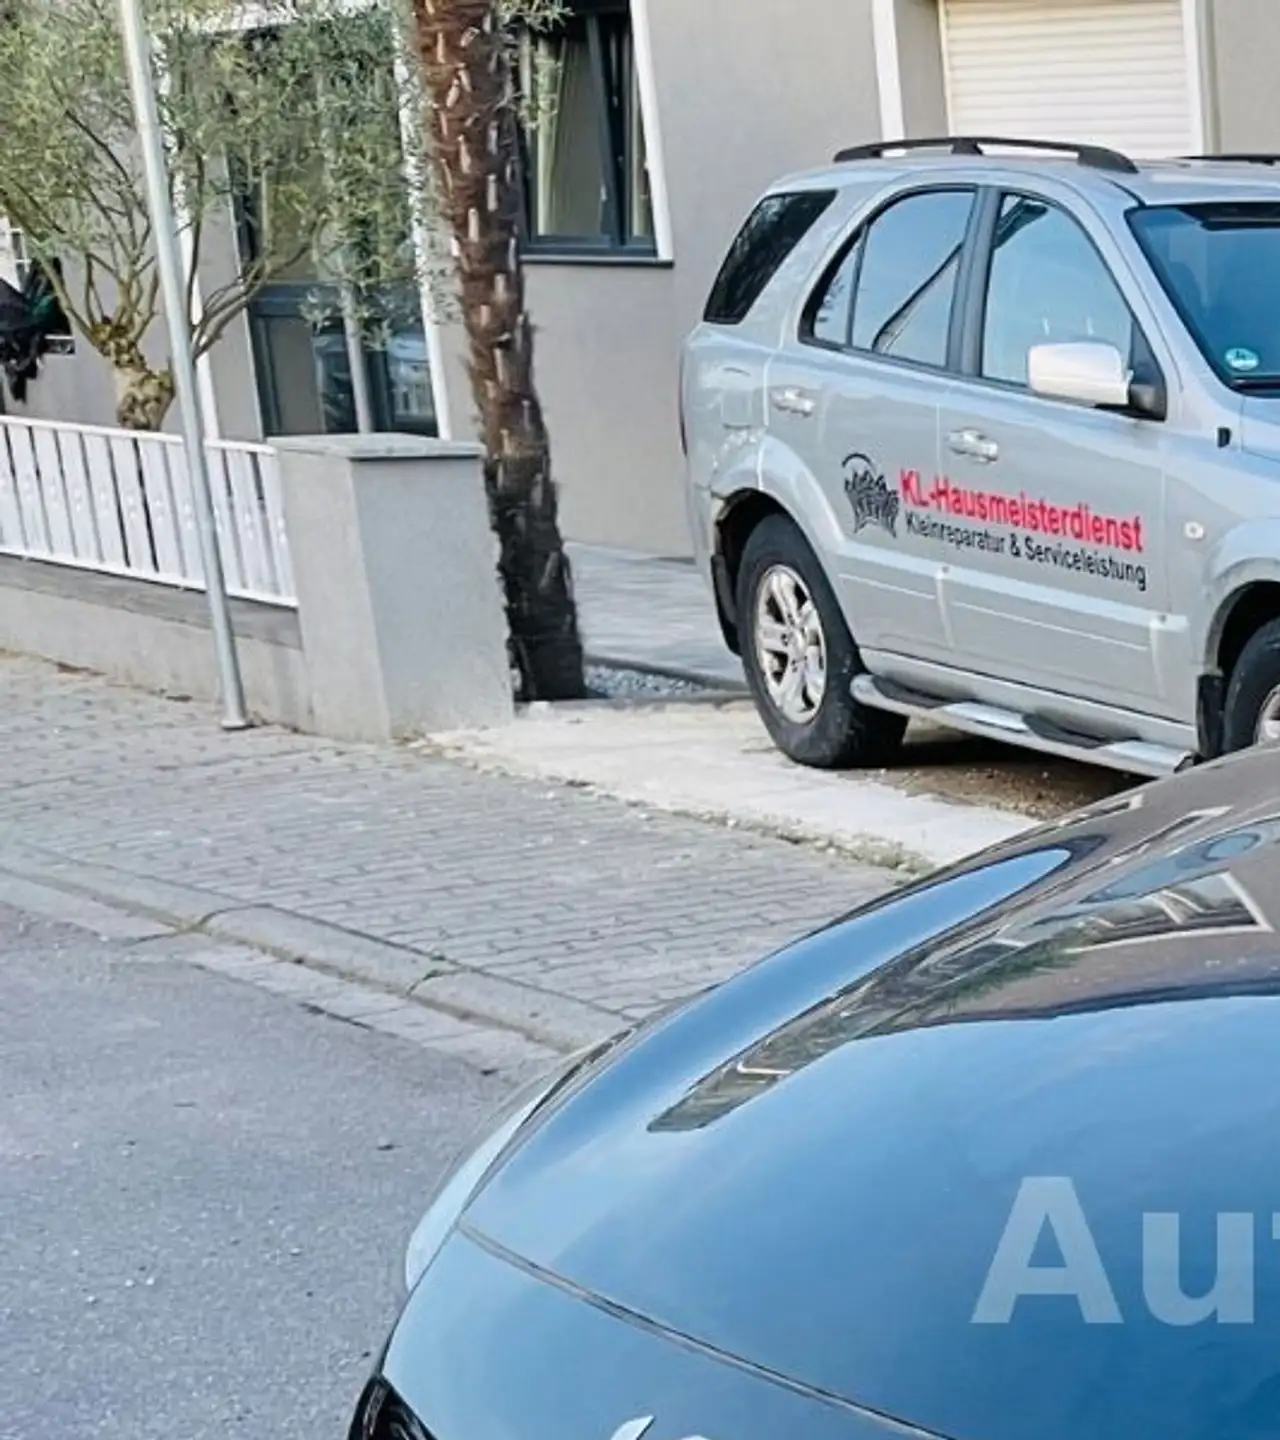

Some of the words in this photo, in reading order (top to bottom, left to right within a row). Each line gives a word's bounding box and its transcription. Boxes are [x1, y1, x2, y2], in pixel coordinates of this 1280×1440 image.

[899, 469, 1144, 553] KL-Hausmeisterdienst
[904, 510, 1005, 556] Kleinreparatur
[1010, 532, 1022, 557] &
[1025, 536, 1147, 591] Serviceleistung
